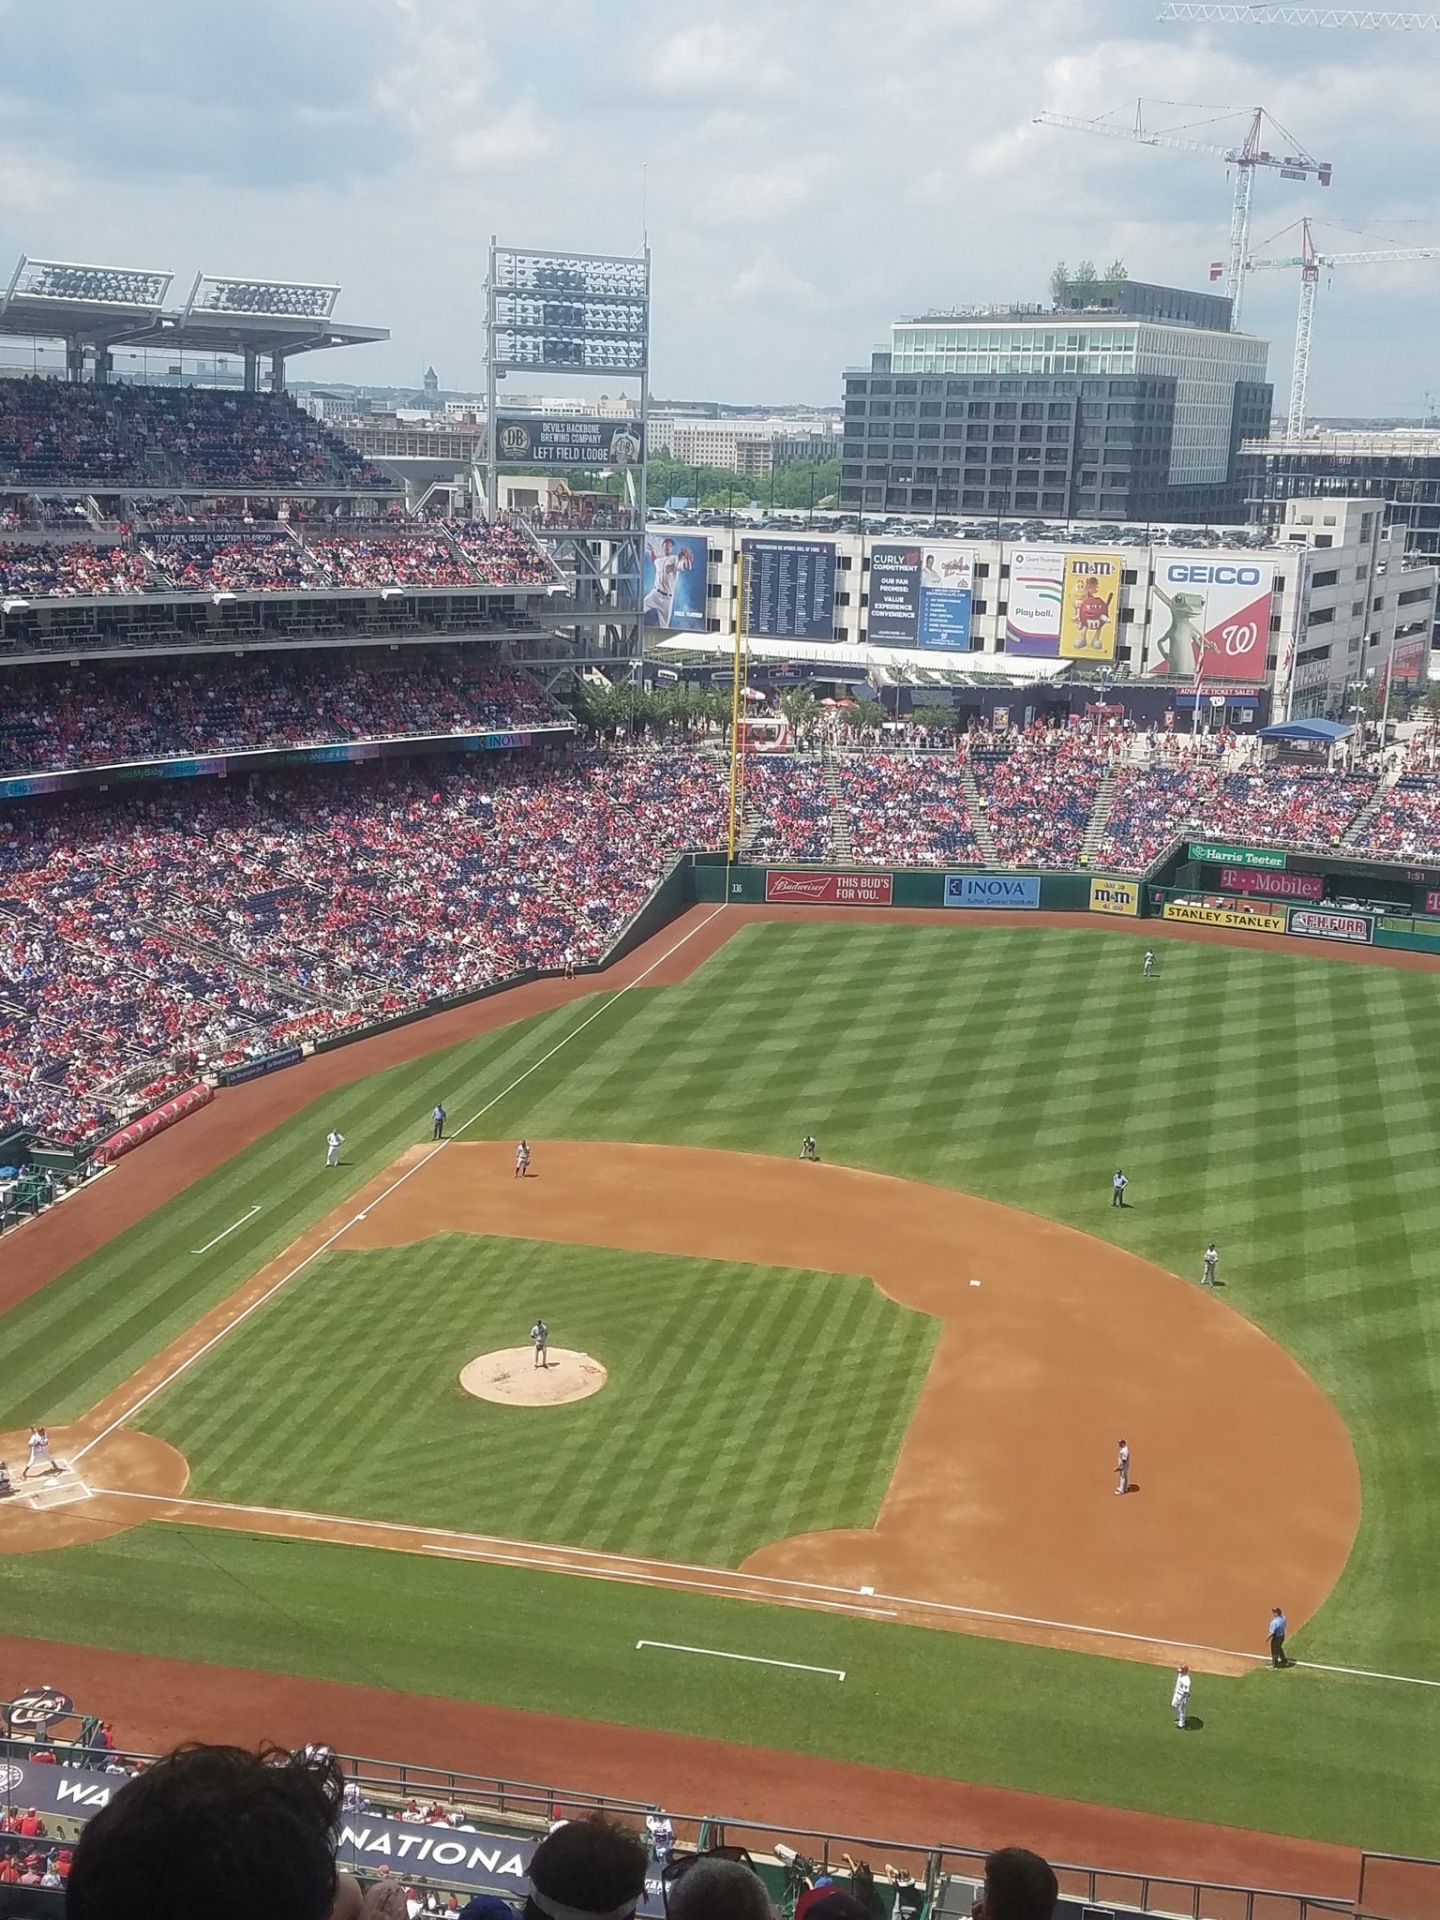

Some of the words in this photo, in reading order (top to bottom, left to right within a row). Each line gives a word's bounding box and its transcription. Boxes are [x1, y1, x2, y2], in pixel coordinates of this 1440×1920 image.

[542, 423, 564, 432] DEVILS
[566, 424, 600, 434] BACKBONE
[508, 429, 524, 446] DB
[540, 433, 570, 443] BREWING
[571, 434, 602, 444] COMPANY
[533, 446, 554, 459] LEFT
[556, 447, 580, 460] FIELD
[582, 448, 608, 461] LODGE
[874, 555, 905, 564] CURLY
[1168, 564, 1260, 586] GEICO
[1016, 608, 1033, 617] Play
[1035, 609, 1053, 617] ball.
[489, 734, 525, 748] INOVA
[1206, 850, 1242, 862] Harris
[1246, 854, 1282, 866] Teeter
[837, 877, 858, 887] THIS
[861, 878, 890, 888] BUD'S
[1407, 872, 1425, 881] 1:51
[732, 883, 742, 893] 336
[776, 880, 824, 892] Budweiser
[968, 882, 1024, 895] INOVA
[836, 889, 856, 899] FOR
[857, 890, 879, 900] YOU.
[1168, 907, 1222, 922] STANLEY
[1226, 914, 1280, 929] STANLEY
[338, 1826, 524, 1878] NATIONA
